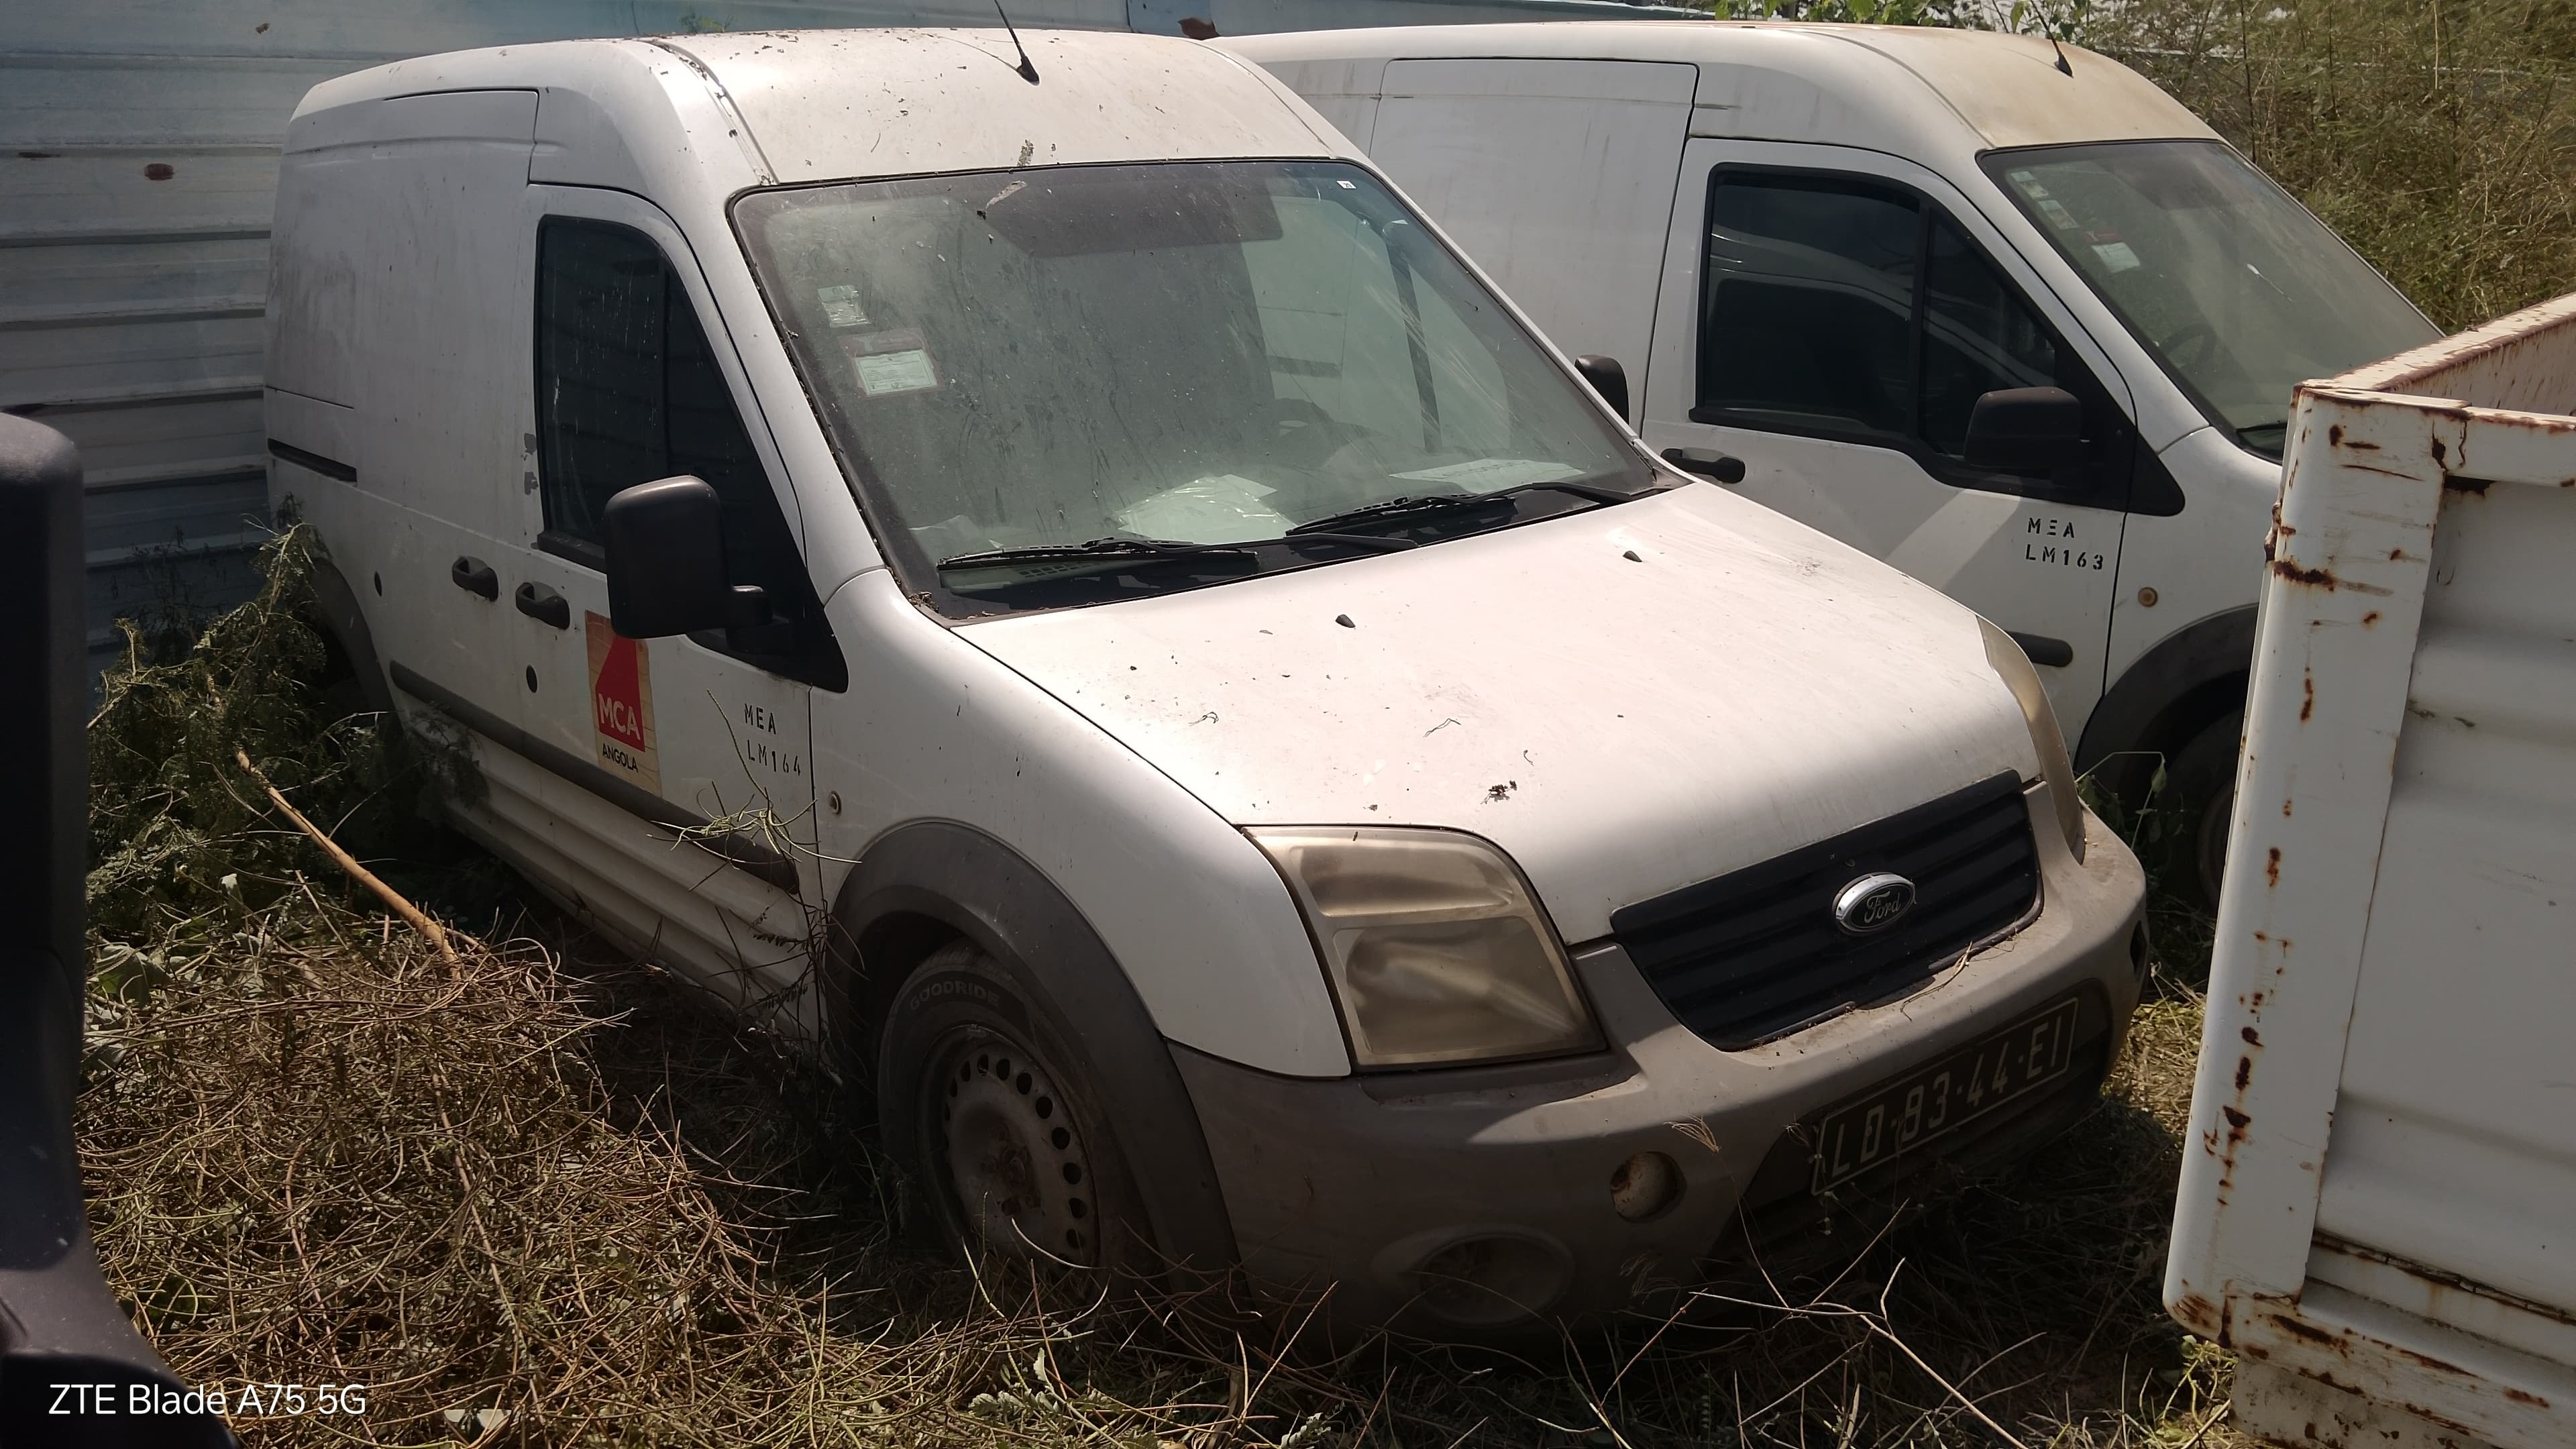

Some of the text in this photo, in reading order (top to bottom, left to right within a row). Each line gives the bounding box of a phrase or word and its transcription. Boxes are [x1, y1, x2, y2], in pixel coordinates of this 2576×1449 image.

[2027, 517, 2075, 538] MEA
[2025, 544, 2104, 570] LM163
[598, 693, 641, 741] MCA
[744, 703, 777, 735] MEA
[602, 743, 639, 773] ANGOLA
[747, 739, 801, 776] LM164
[1864, 890, 1901, 923] Ford
[910, 980, 1000, 1010] GOODRIDE
